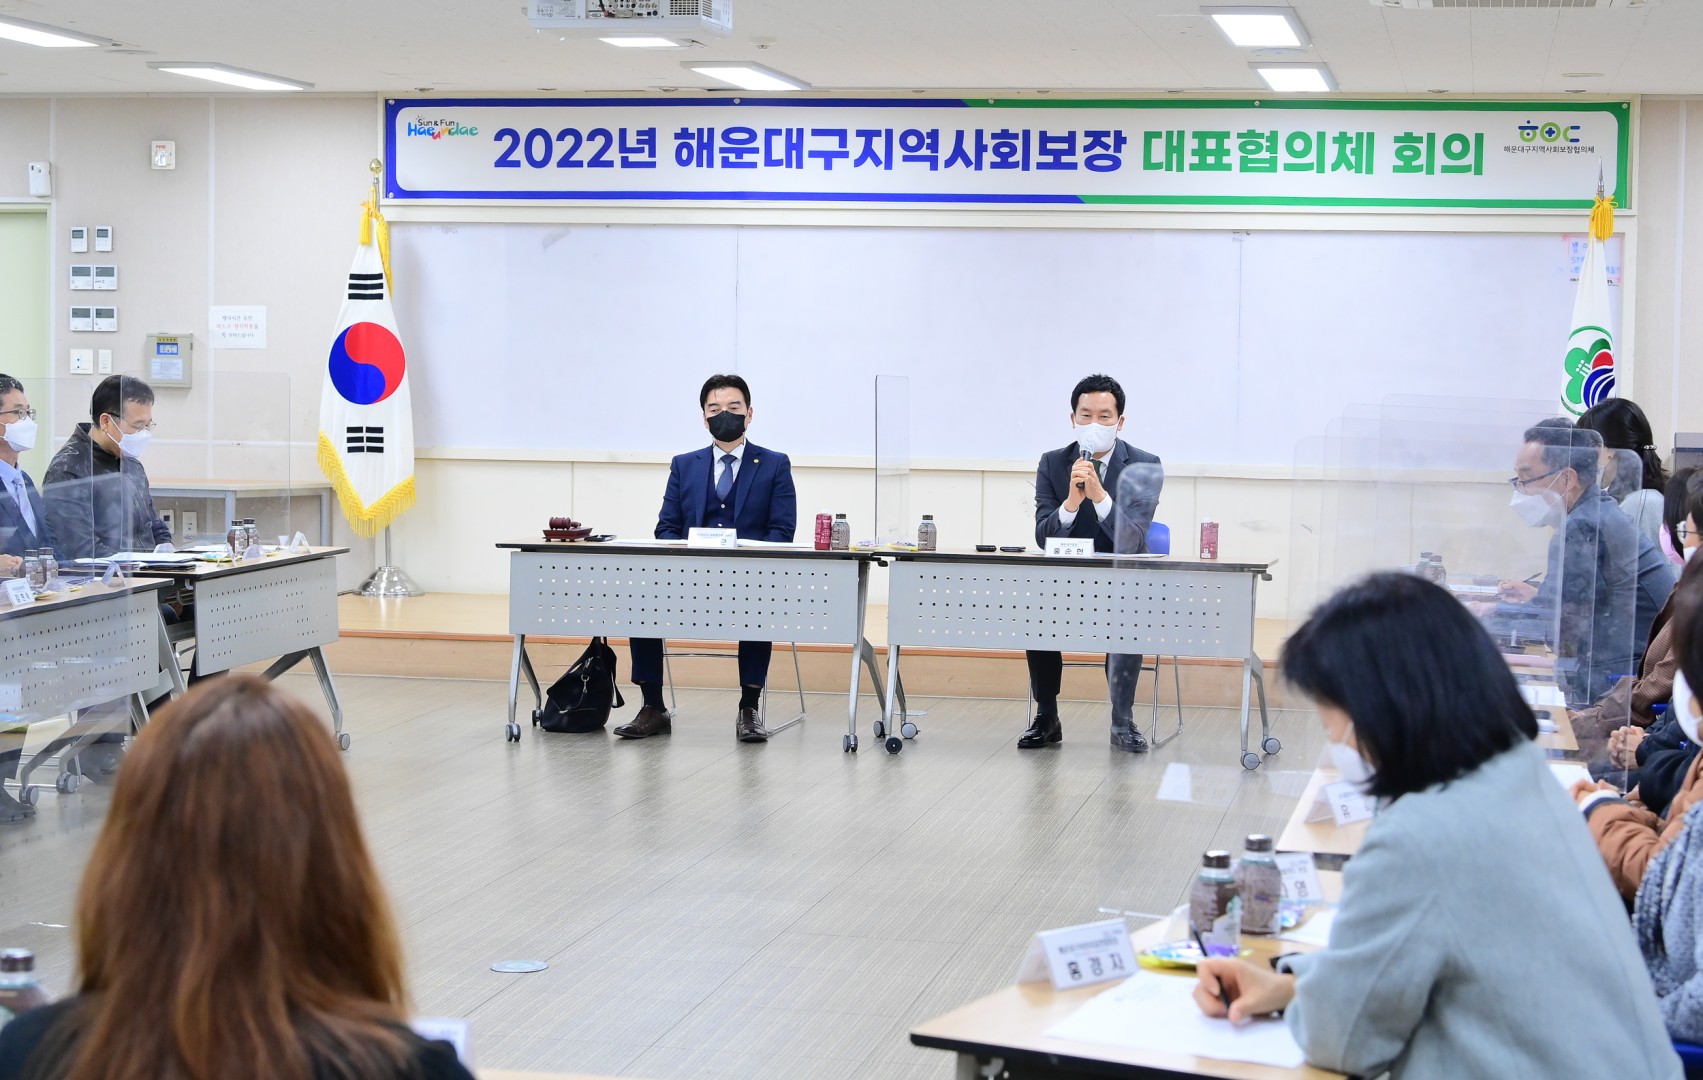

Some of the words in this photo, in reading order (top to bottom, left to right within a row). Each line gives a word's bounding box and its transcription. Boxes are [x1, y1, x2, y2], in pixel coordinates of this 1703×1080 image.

[417, 119, 433, 127] Sun
[440, 119, 456, 127] Fun
[407, 121, 479, 140] Haeundae
[493, 127, 657, 169] 2022년
[674, 126, 1128, 173] 해운대구지역사회보장
[1143, 129, 1375, 175] 대표협의체
[1392, 132, 1485, 176] 회의
[1503, 145, 1595, 154] 해운대구지역사회보장협의체
